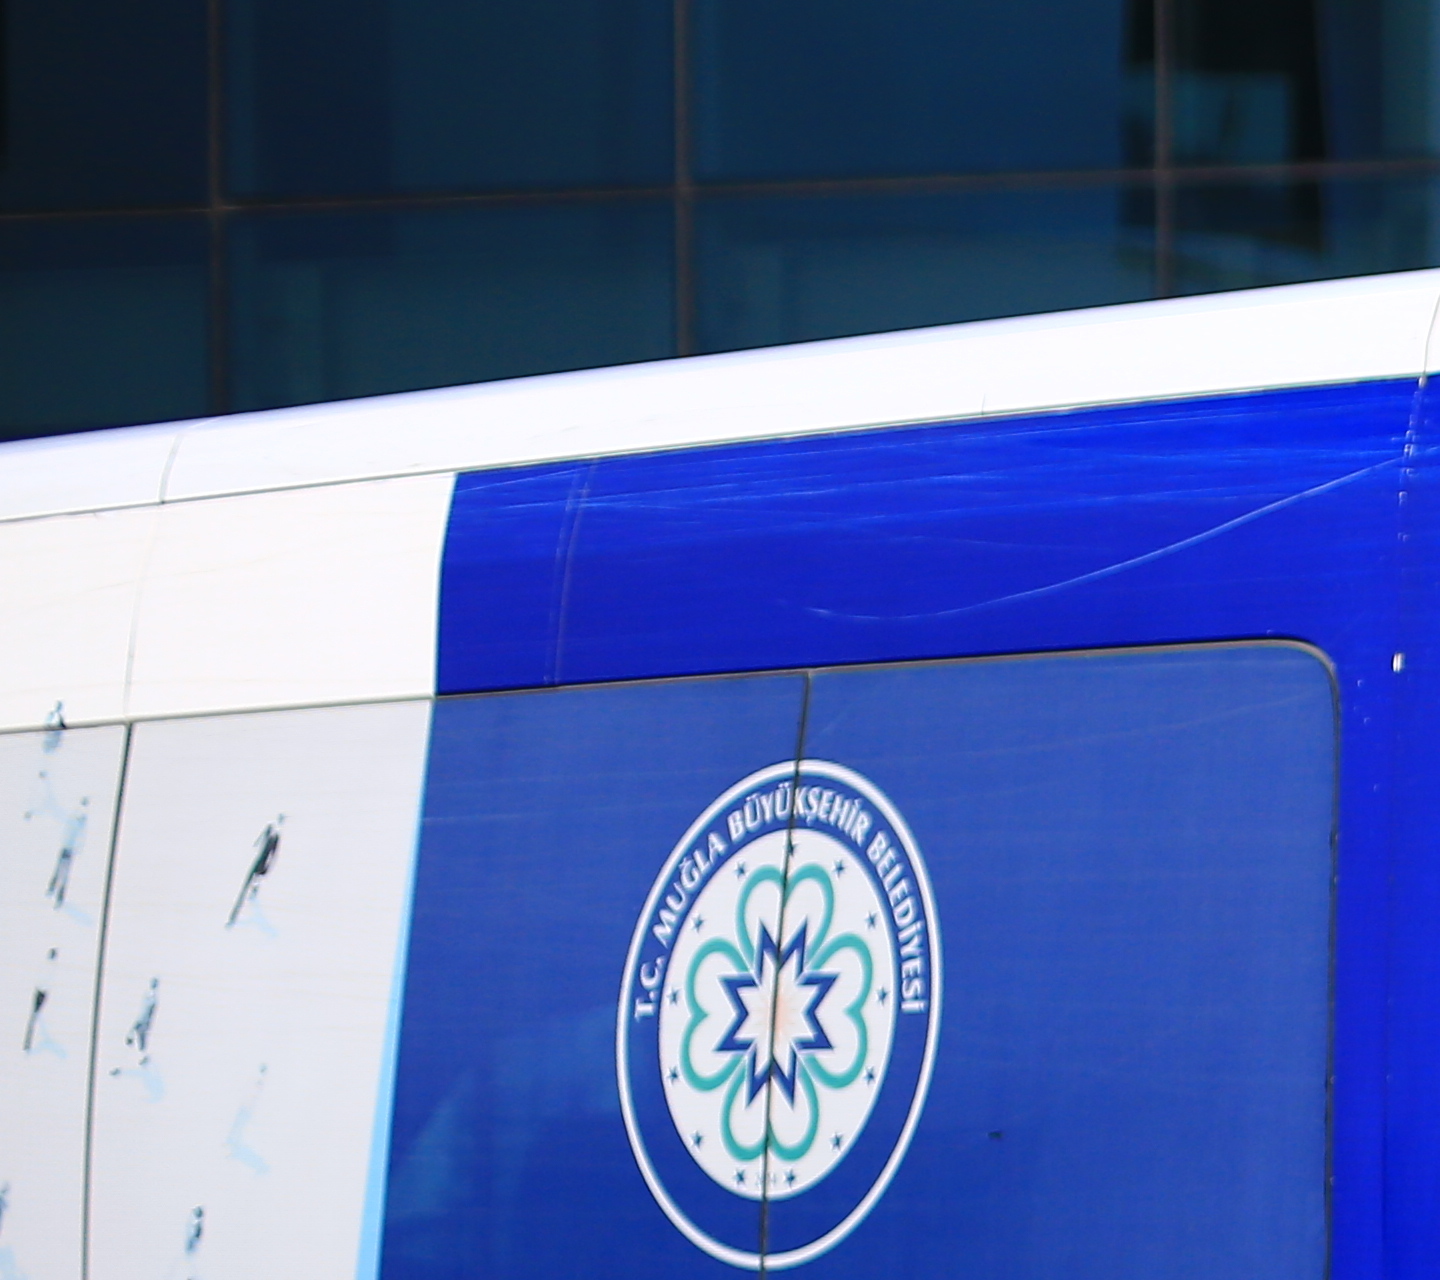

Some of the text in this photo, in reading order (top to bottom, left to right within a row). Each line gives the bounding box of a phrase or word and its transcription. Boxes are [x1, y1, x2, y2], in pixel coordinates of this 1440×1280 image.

[634, 781, 926, 1022] T.C. MUĞLA BÜYÜKŞEHİR BELEDİYESİ
